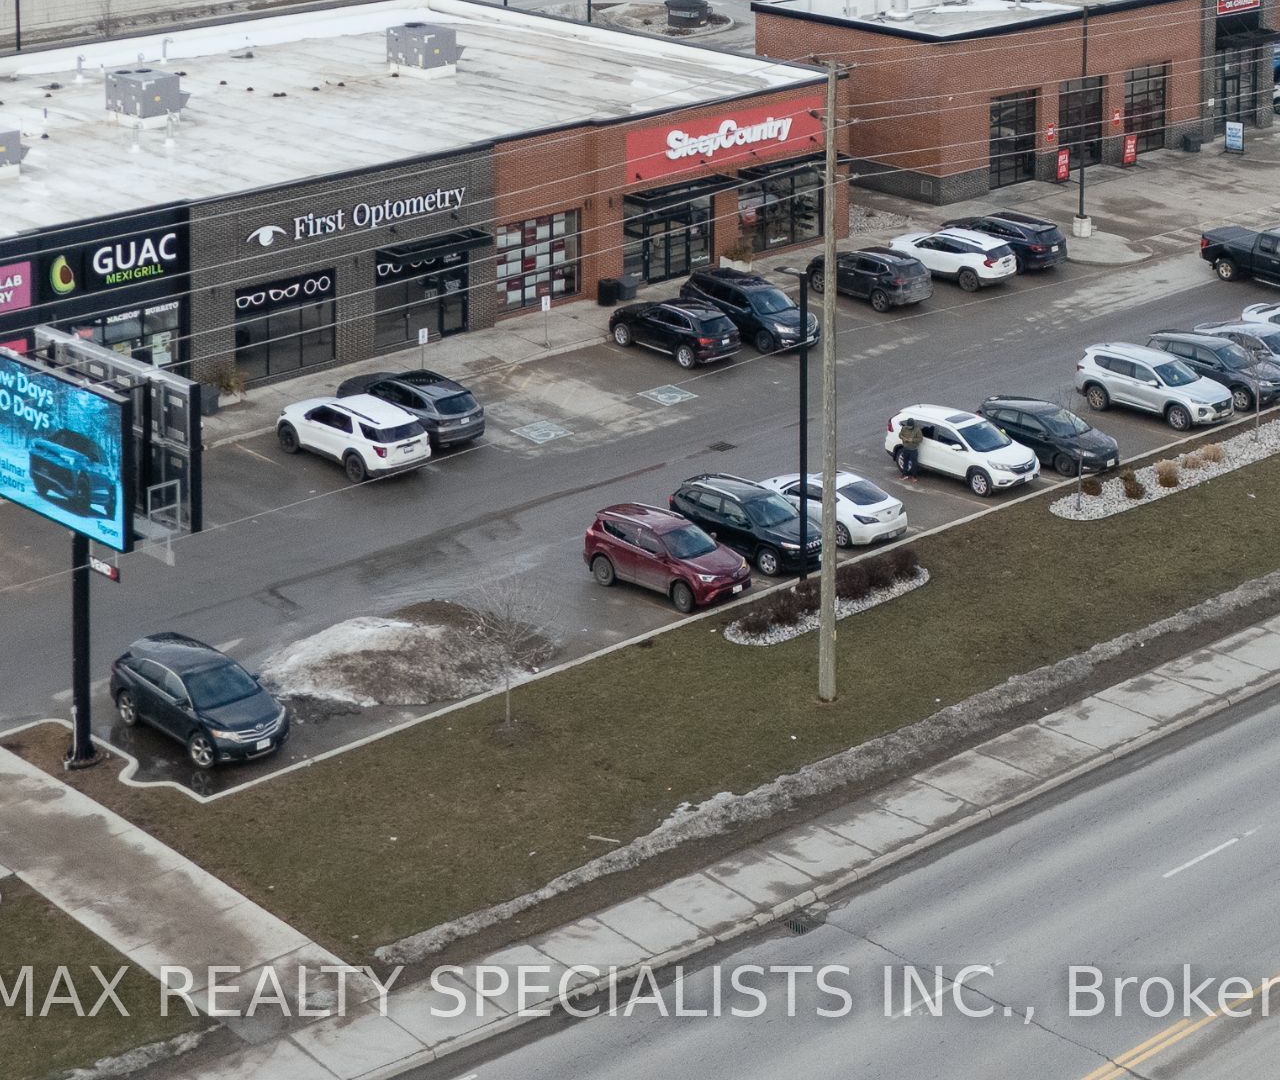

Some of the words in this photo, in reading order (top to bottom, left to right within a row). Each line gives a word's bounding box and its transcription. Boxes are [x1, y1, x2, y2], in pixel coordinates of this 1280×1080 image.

[293, 208, 346, 240] First
[352, 186, 467, 229] Optometry
[92, 232, 178, 275] GUAC
[106, 271, 133, 285] MEXI
[133, 263, 164, 278] GRILL
[17, 372, 54, 407] Days
[13, 396, 50, 430] Days
